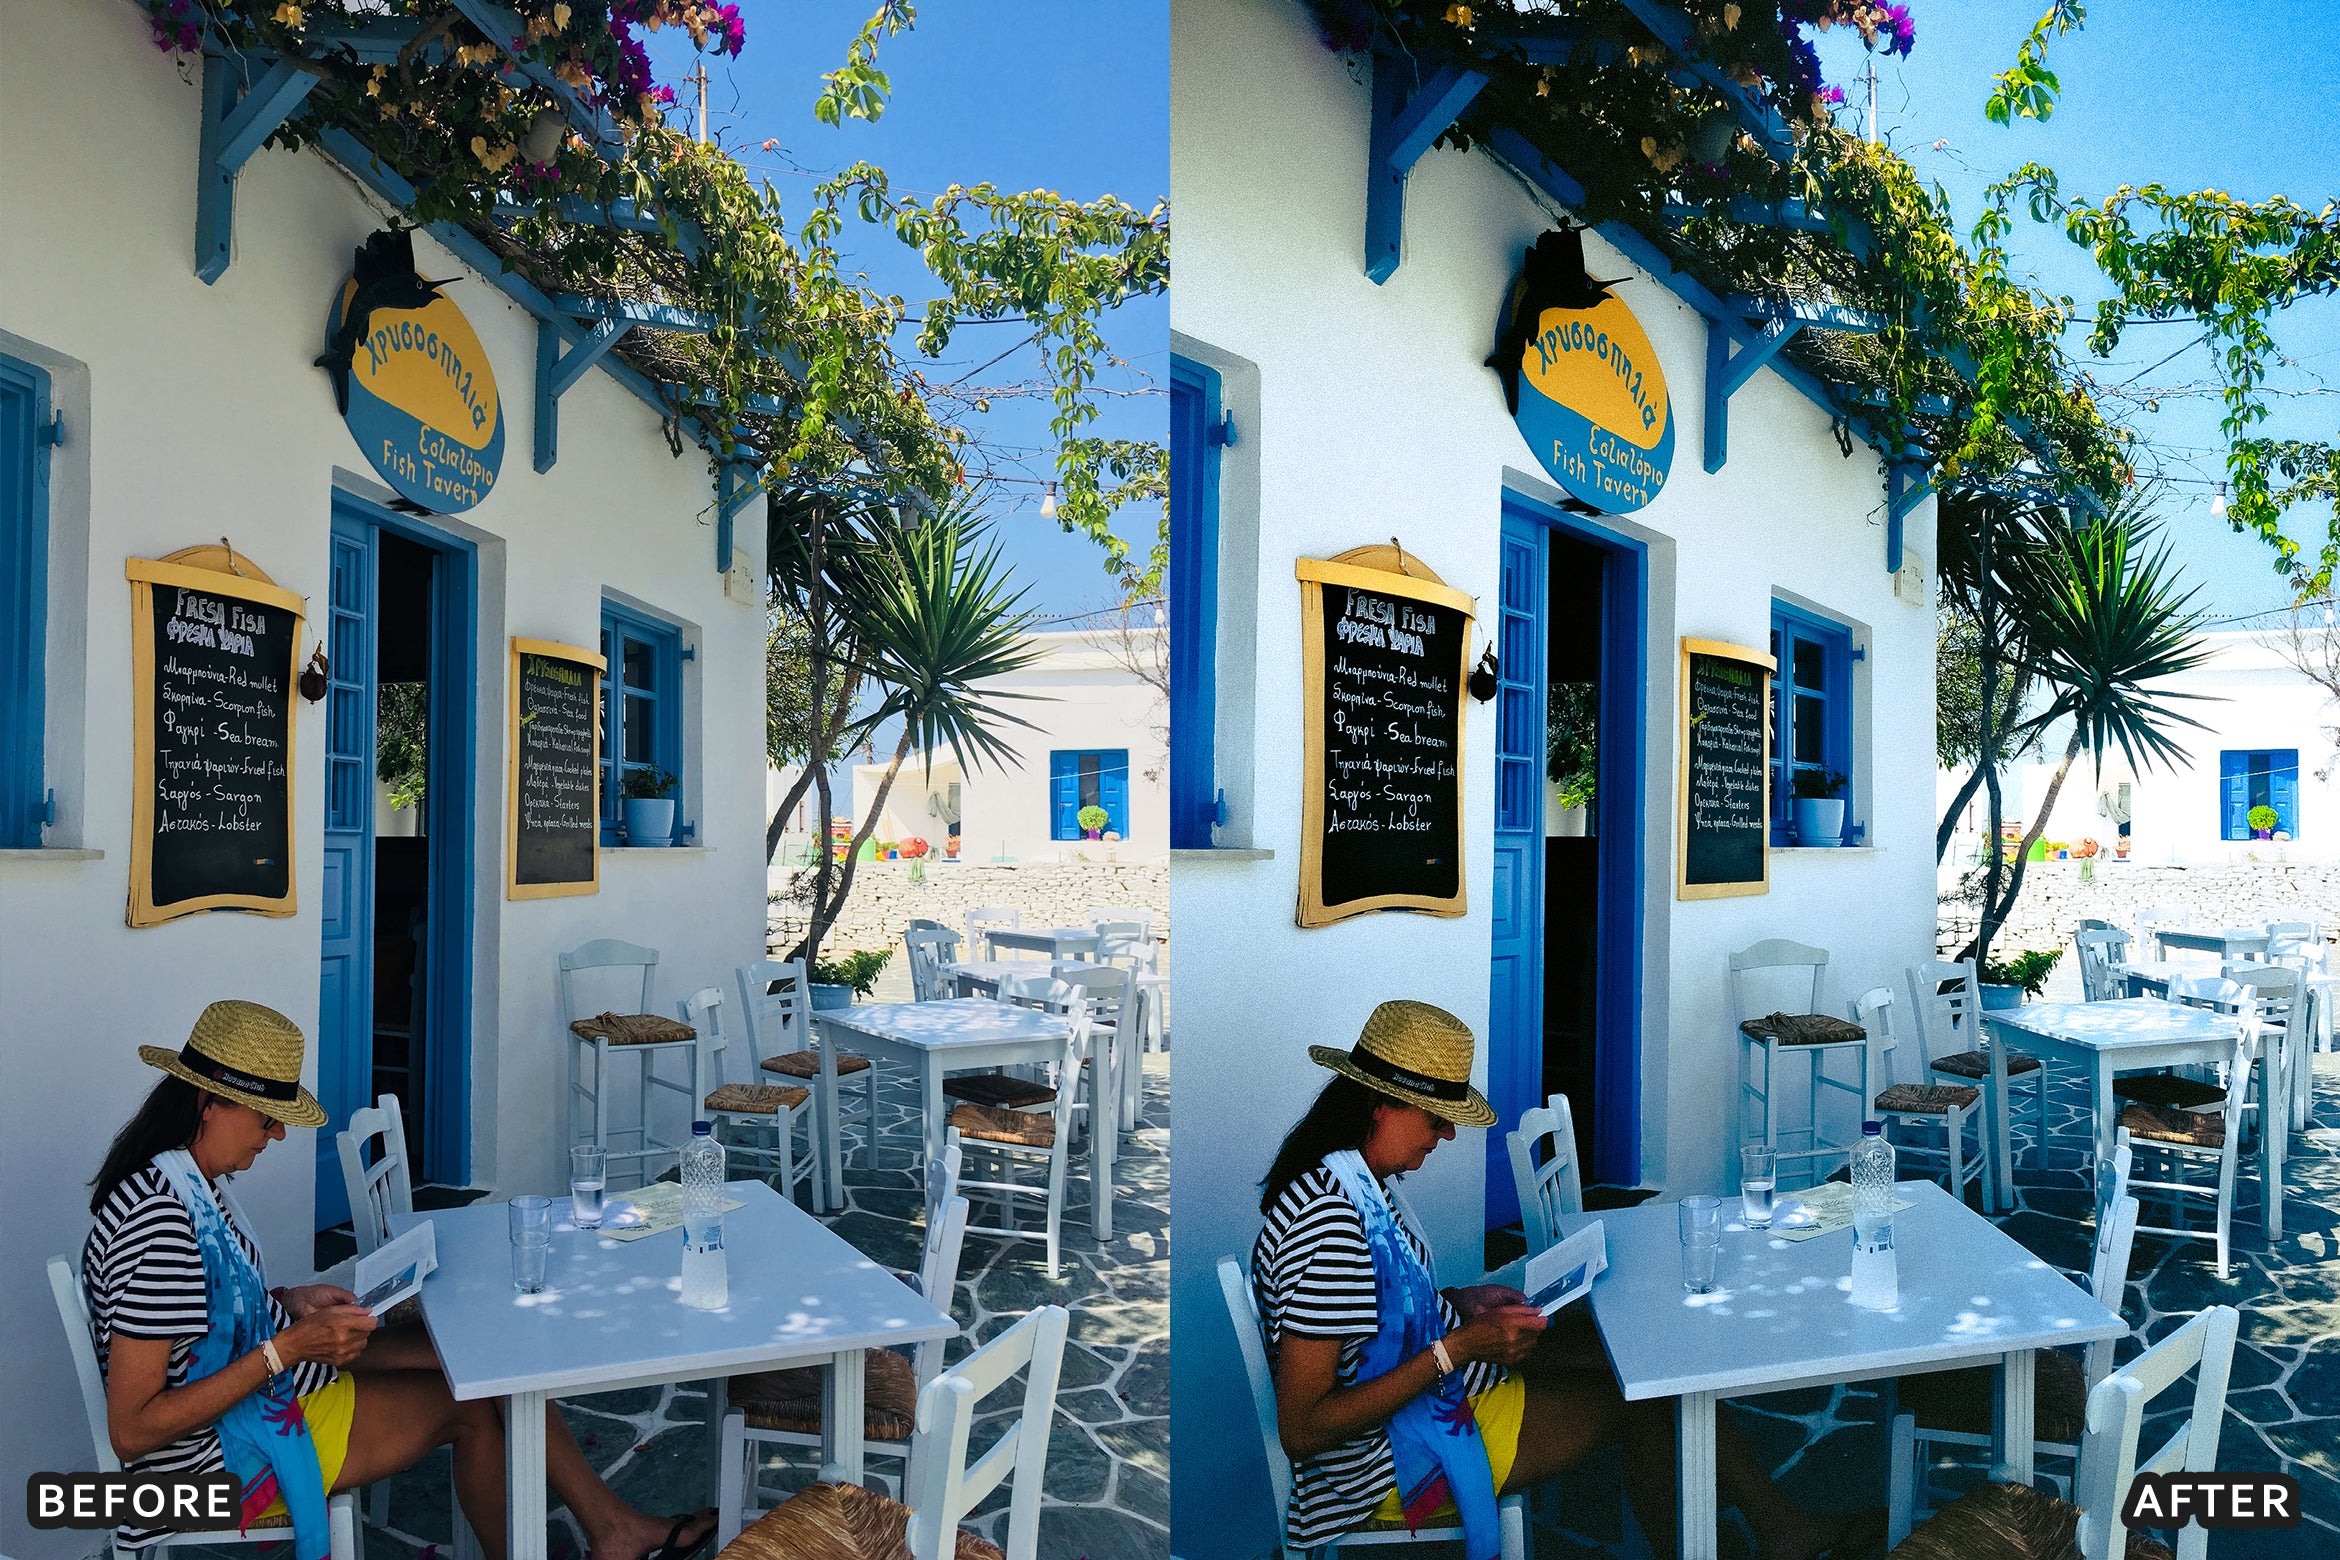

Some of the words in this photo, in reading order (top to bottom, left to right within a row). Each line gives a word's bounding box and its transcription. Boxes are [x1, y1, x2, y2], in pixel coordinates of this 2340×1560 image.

[1553, 439, 1586, 483] Fish
[383, 439, 416, 483] Fish
[423, 459, 478, 507] Tavern
[250, 676, 277, 692] mullet
[1420, 676, 1447, 692] mullet
[267, 760, 286, 781] fish
[1437, 760, 1456, 781] fish
[213, 784, 262, 817] Sargon
[554, 794, 580, 810] Starters
[218, 811, 262, 831] Lobster
[1388, 811, 1432, 831] Lobster
